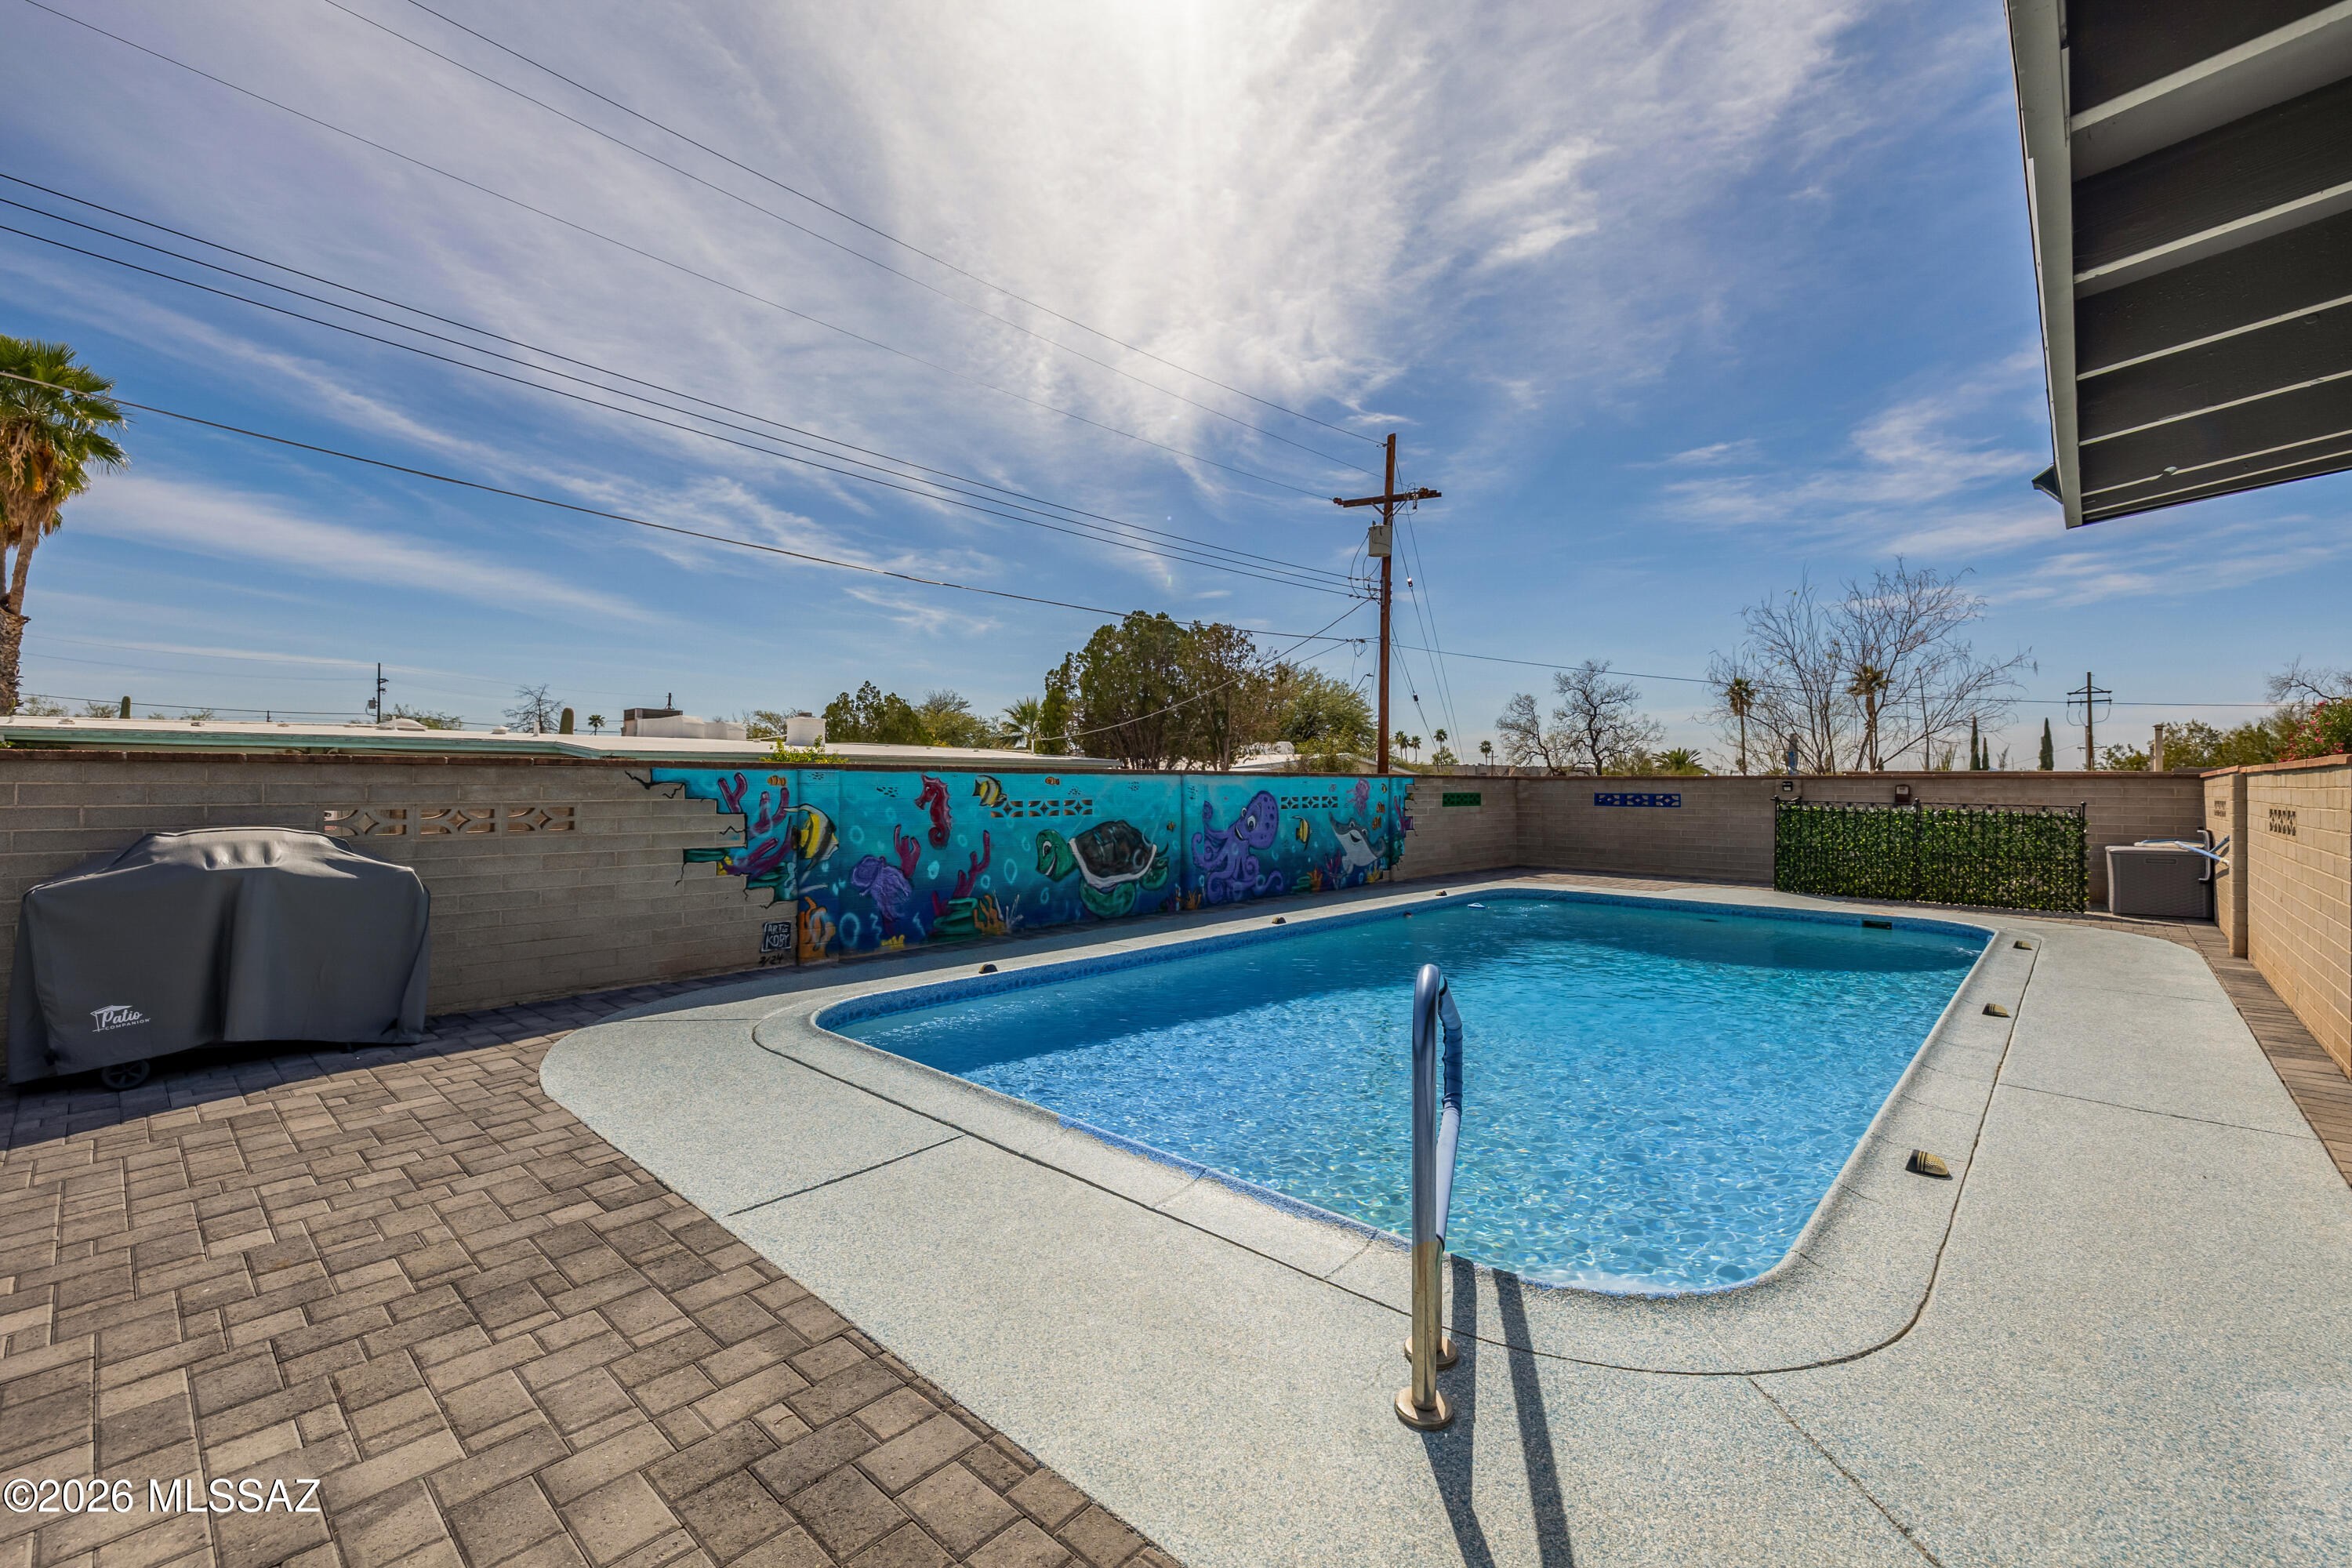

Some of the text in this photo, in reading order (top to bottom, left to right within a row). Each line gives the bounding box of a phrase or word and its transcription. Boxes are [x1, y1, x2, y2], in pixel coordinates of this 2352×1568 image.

[765, 934, 789, 949] KOBY
[102, 1009, 143, 1028] Patio
[105, 1019, 150, 1030] COMPANION
